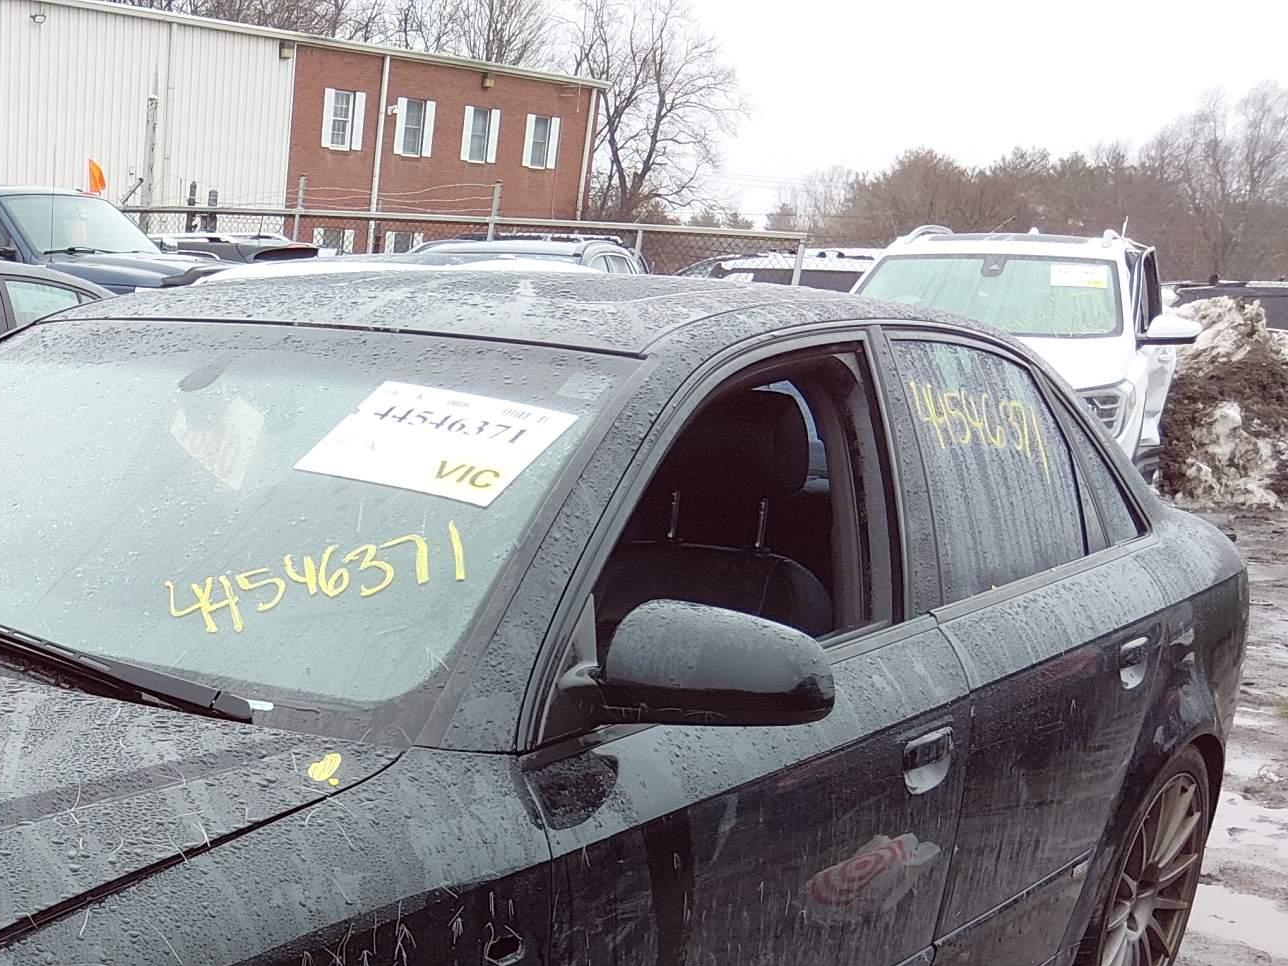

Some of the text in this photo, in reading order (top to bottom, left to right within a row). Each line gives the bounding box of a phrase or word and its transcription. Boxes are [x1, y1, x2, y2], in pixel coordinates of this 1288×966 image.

[373, 405, 527, 444] 44546371
[910, 380, 1050, 485] 44546371
[434, 460, 500, 489] VIC
[164, 520, 466, 632] 44546371
